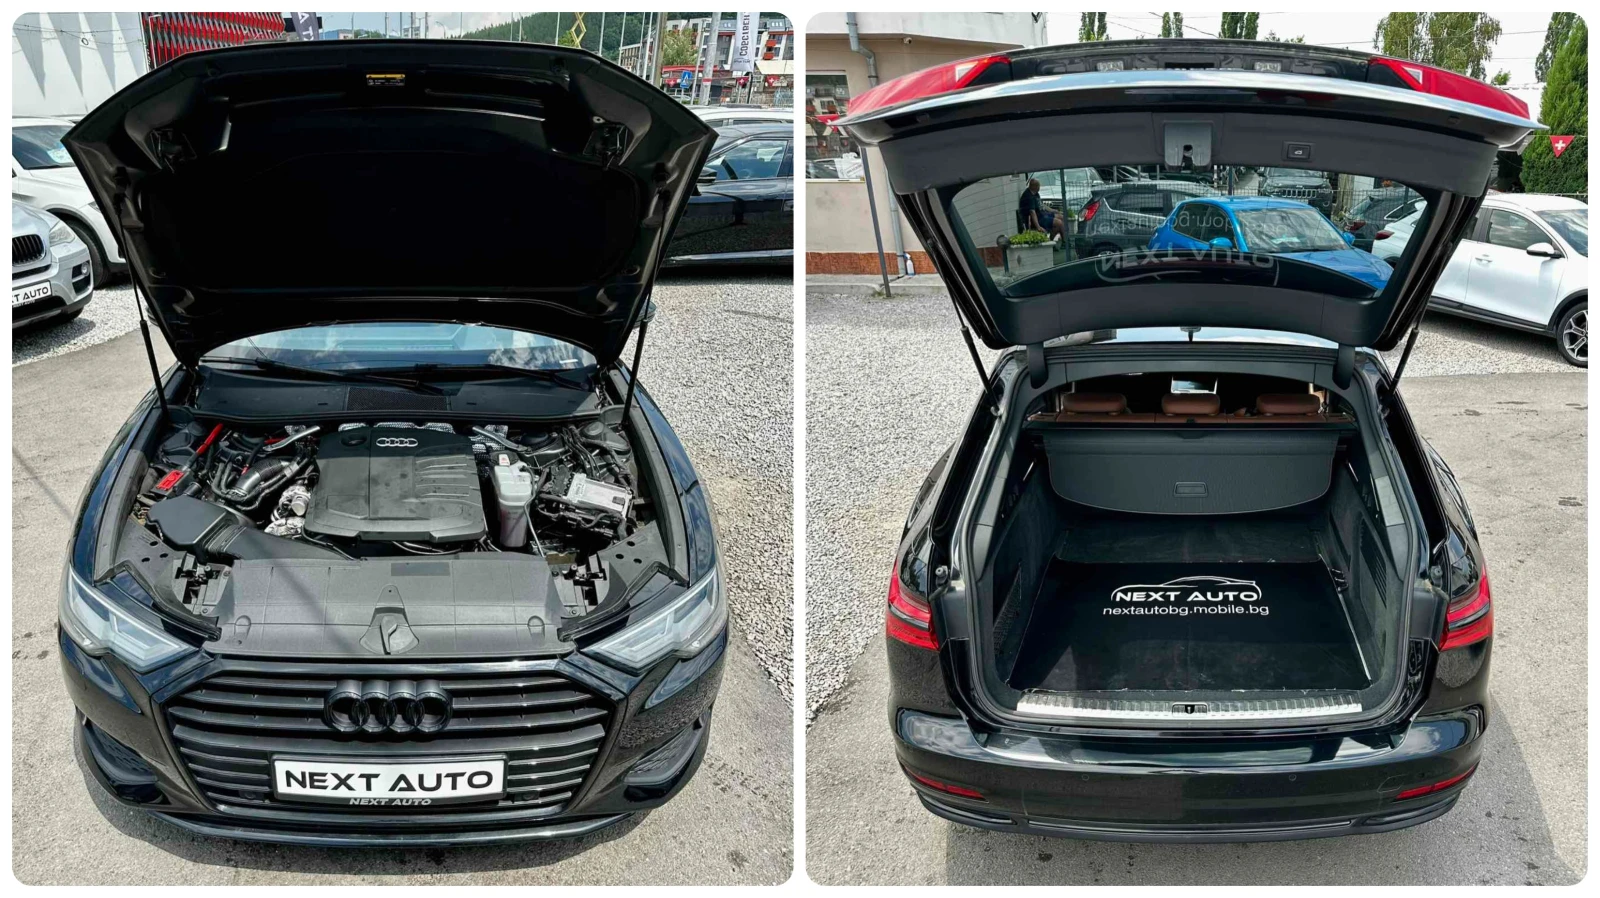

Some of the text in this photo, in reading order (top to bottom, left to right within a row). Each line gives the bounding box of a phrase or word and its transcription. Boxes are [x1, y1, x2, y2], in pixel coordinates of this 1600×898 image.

[23, 286, 49, 301] AUTO
[1115, 591, 1258, 602] NEXT AUTO
[1103, 604, 1269, 616] nextautobg.mobile.bg
[285, 769, 493, 792] NEXT AUTO
[349, 798, 432, 806] NEXT AUTO
